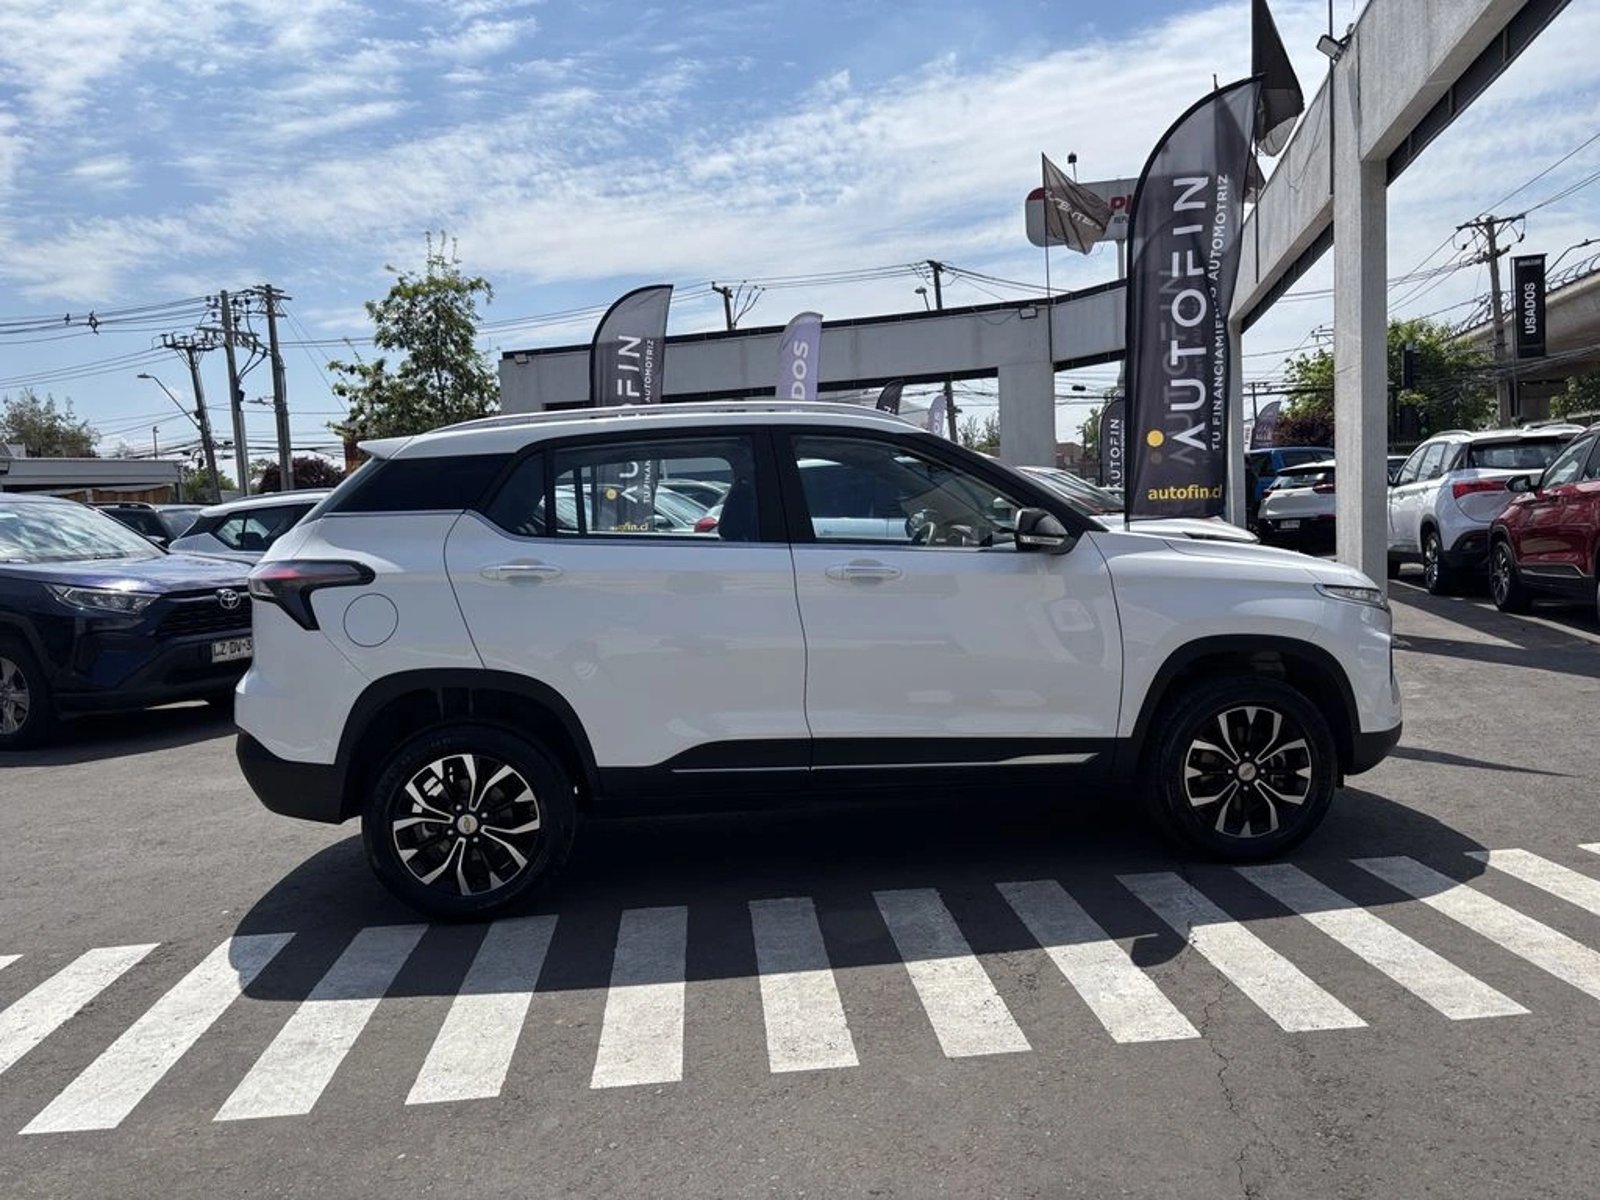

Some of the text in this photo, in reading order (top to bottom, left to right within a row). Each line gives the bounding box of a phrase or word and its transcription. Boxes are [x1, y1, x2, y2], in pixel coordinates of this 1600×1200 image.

[1171, 176, 1209, 451] AUTOFIN
[1208, 173, 1229, 450] TU FINANCIAMIE AUTOMOTRIZ
[1524, 282, 1537, 335] USADOS
[617, 336, 641, 398] FIN
[642, 339, 655, 402] AUTOMOTRIZ
